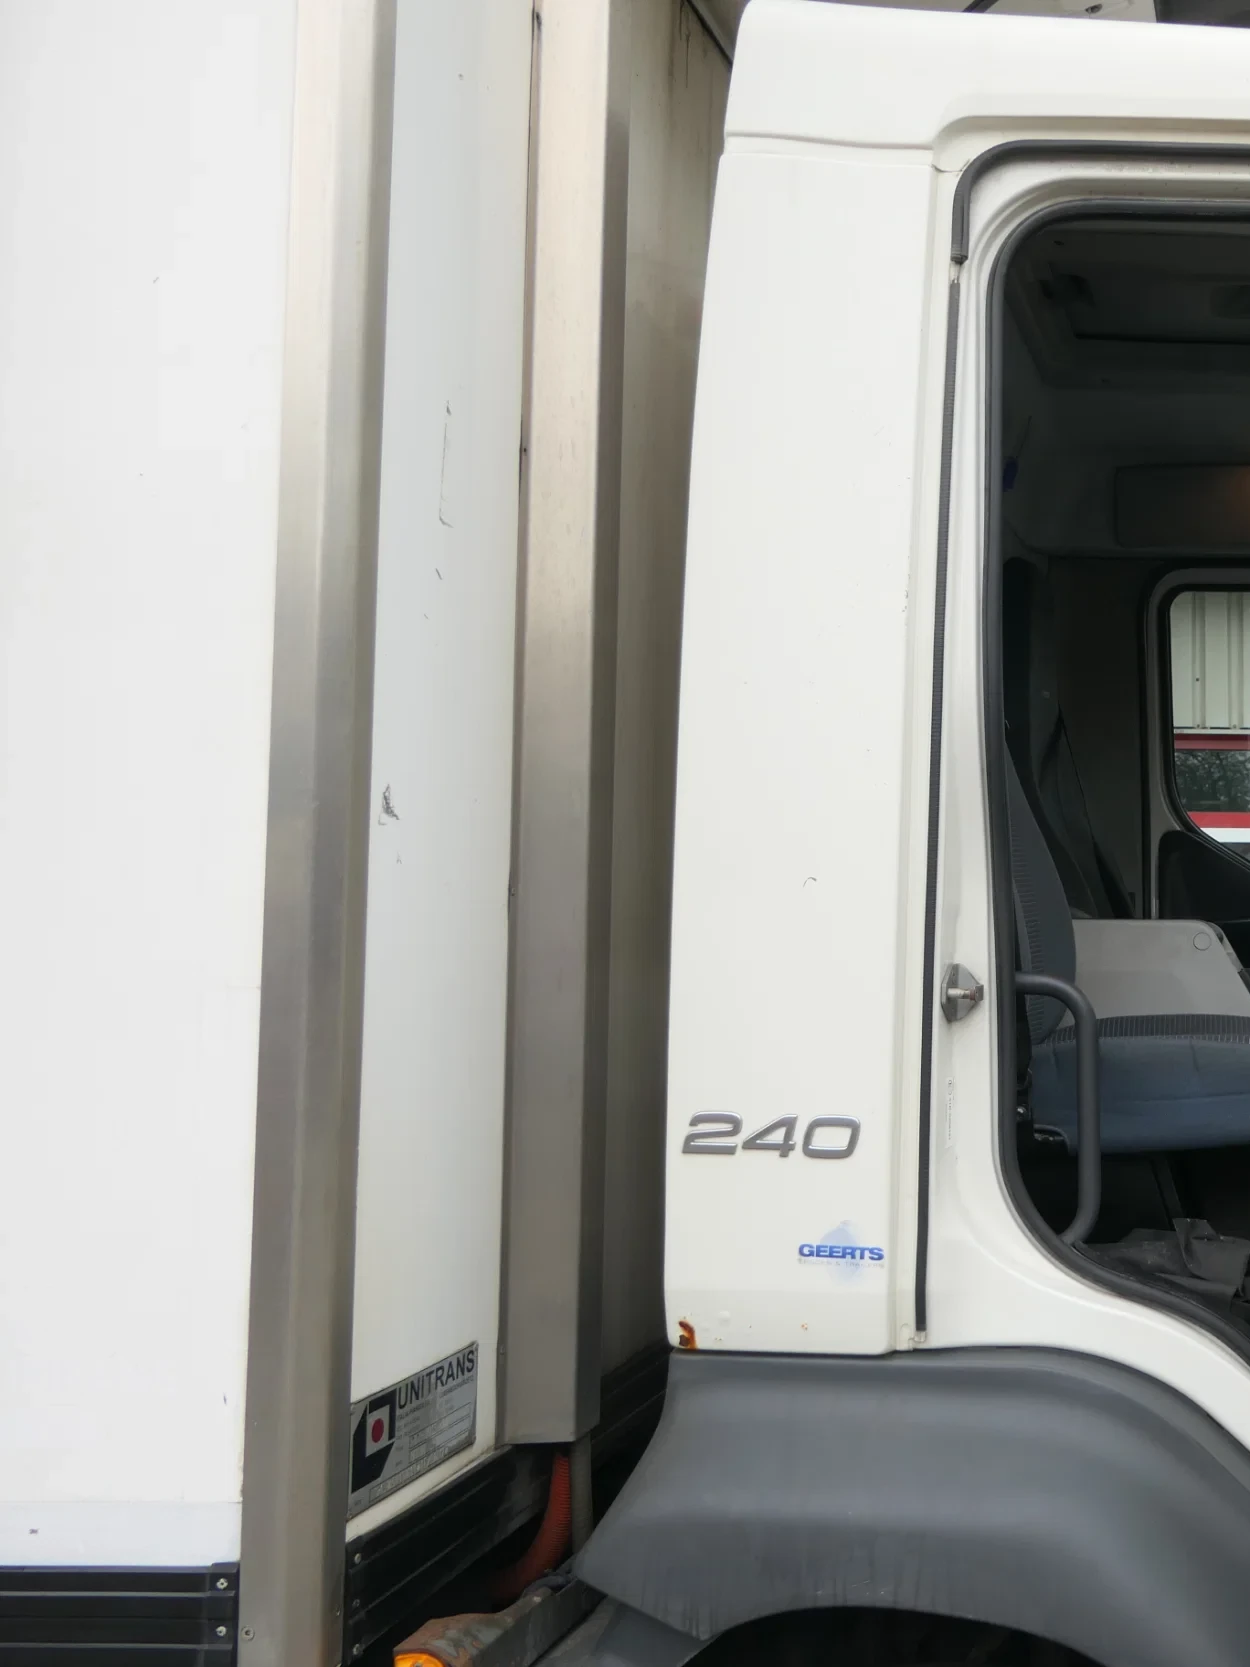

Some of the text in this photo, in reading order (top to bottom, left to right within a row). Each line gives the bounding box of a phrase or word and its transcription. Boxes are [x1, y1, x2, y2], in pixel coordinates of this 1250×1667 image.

[682, 1110, 861, 1159] 240
[798, 1243, 885, 1261] GEERTS
[397, 1349, 475, 1410] UNITRANS
